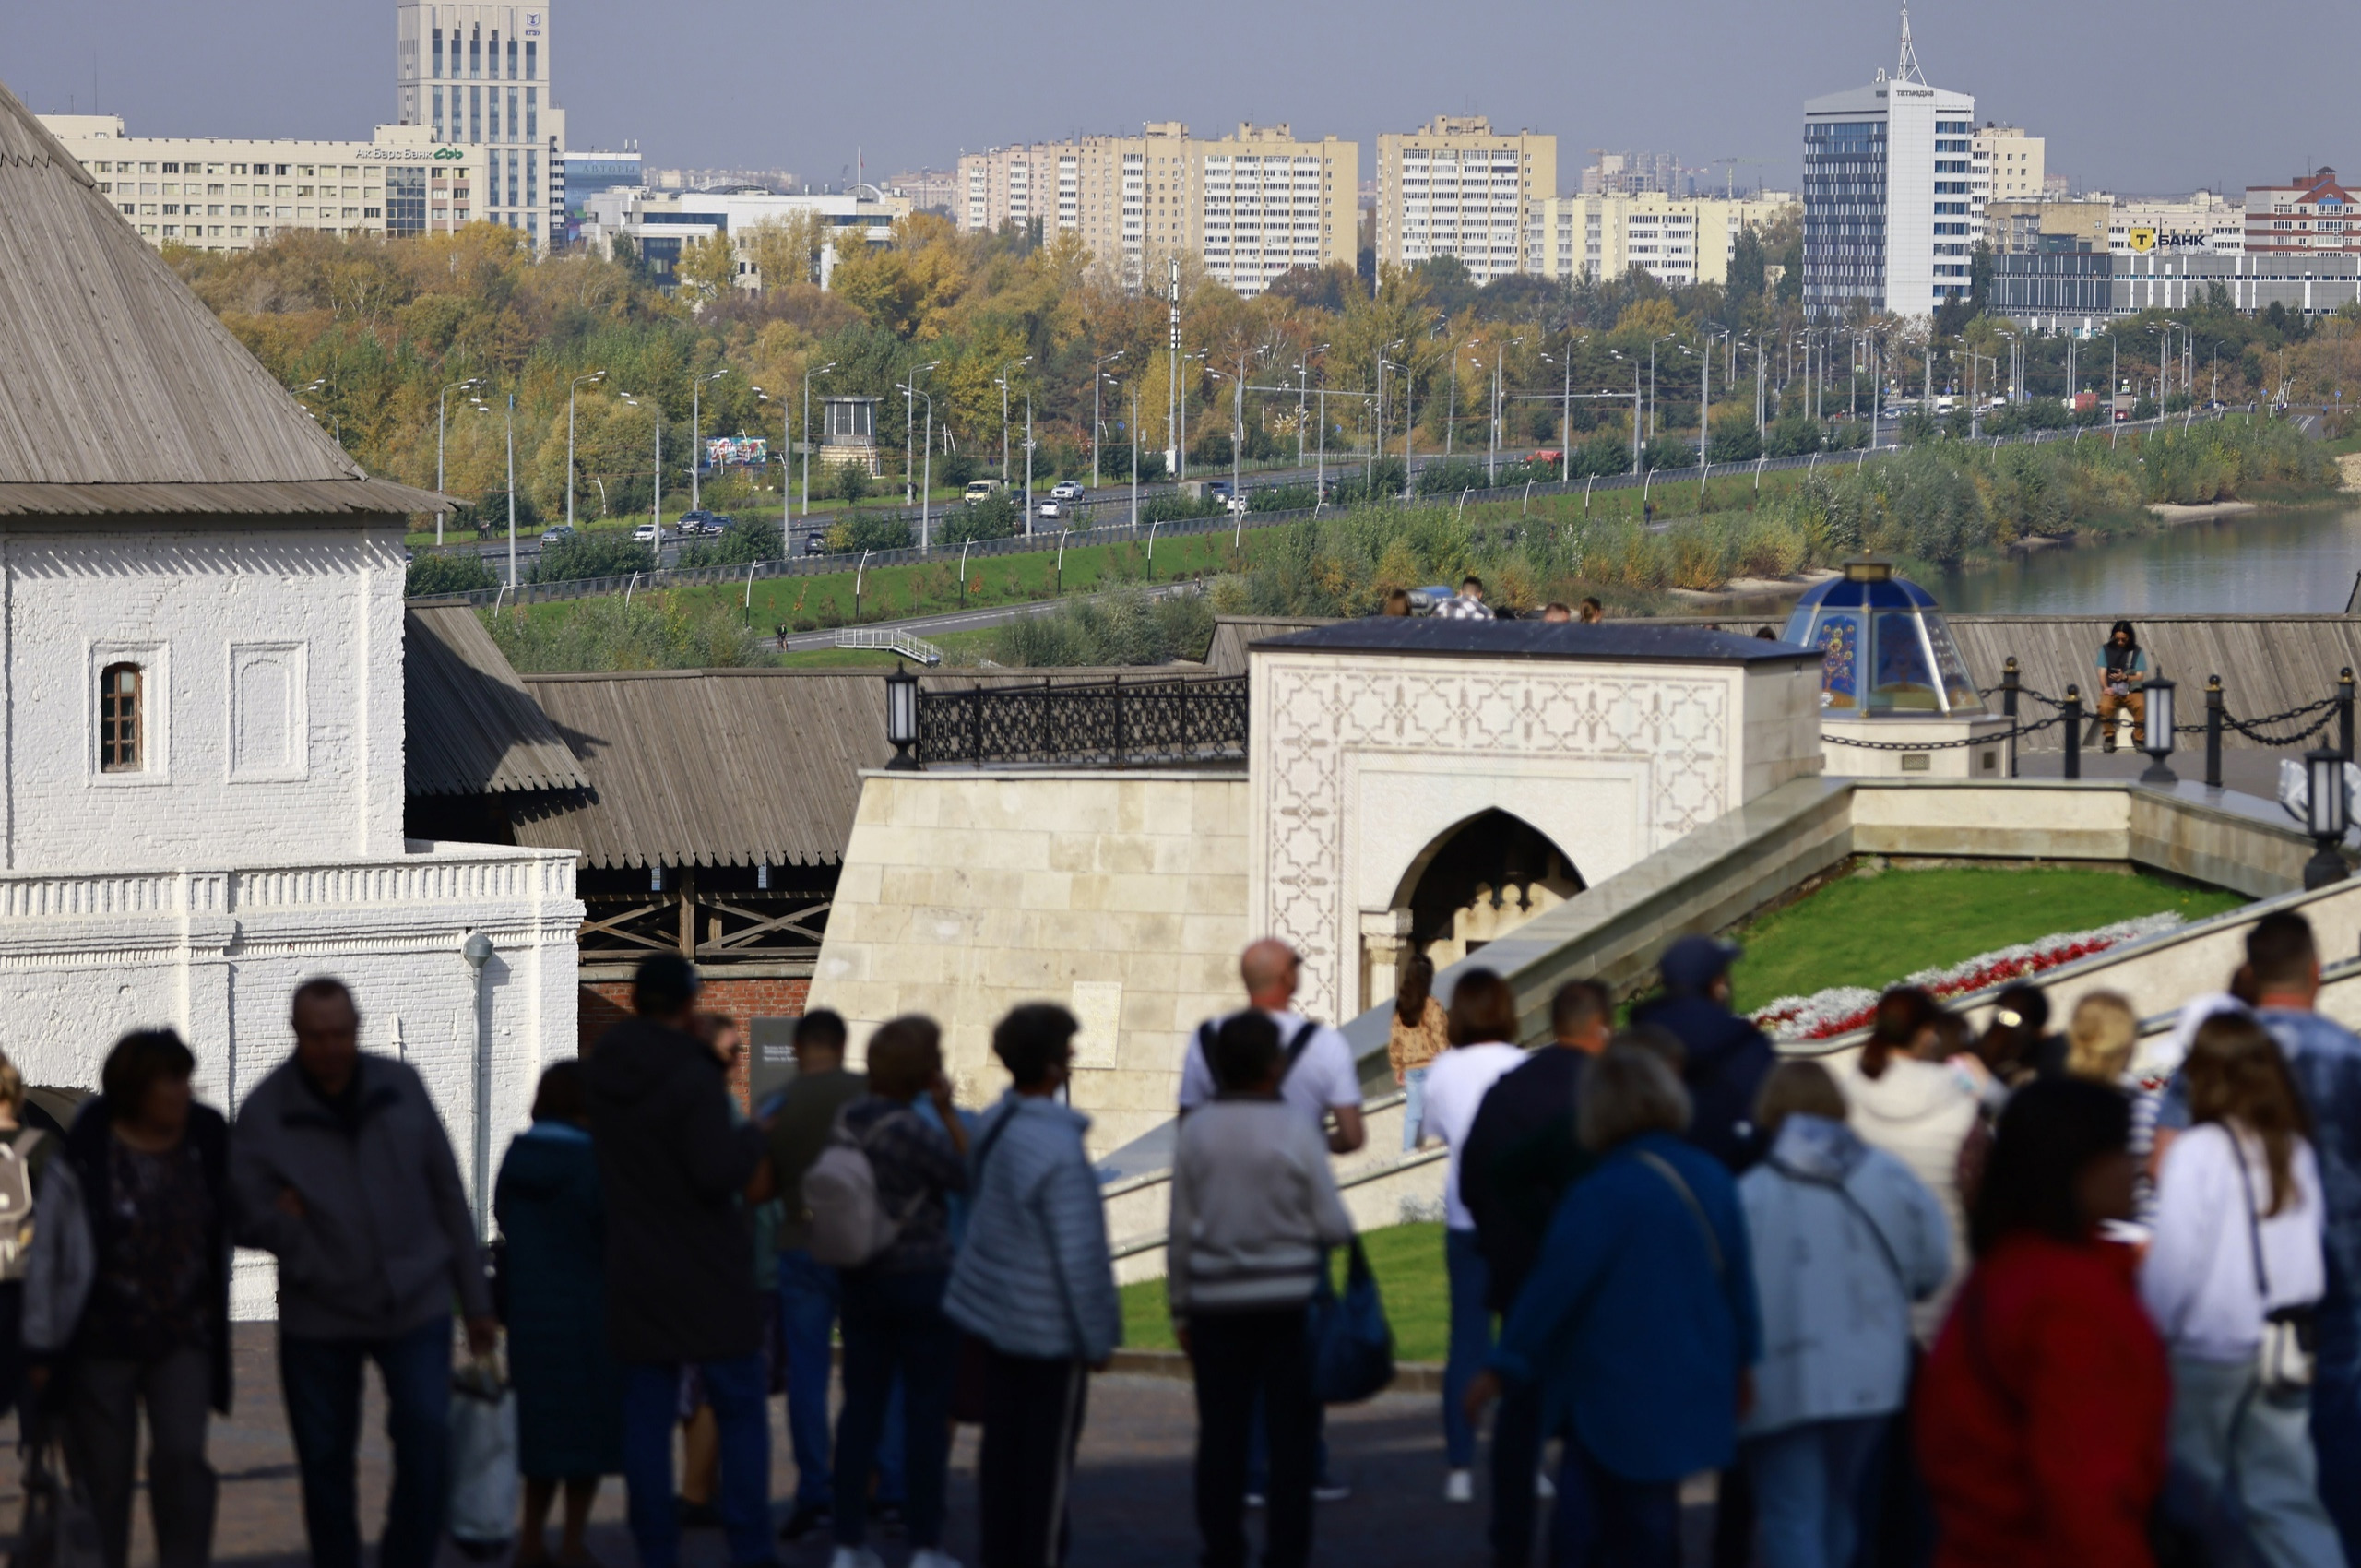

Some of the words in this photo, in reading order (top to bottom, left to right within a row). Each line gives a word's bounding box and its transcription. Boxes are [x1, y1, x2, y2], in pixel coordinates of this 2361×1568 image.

[356, 148, 371, 159] Ак
[374, 148, 401, 160] Барс
[404, 148, 432, 160] Банк
[582, 164, 635, 173] АВТОРЫ
[2158, 234, 2205, 246] БАНК
